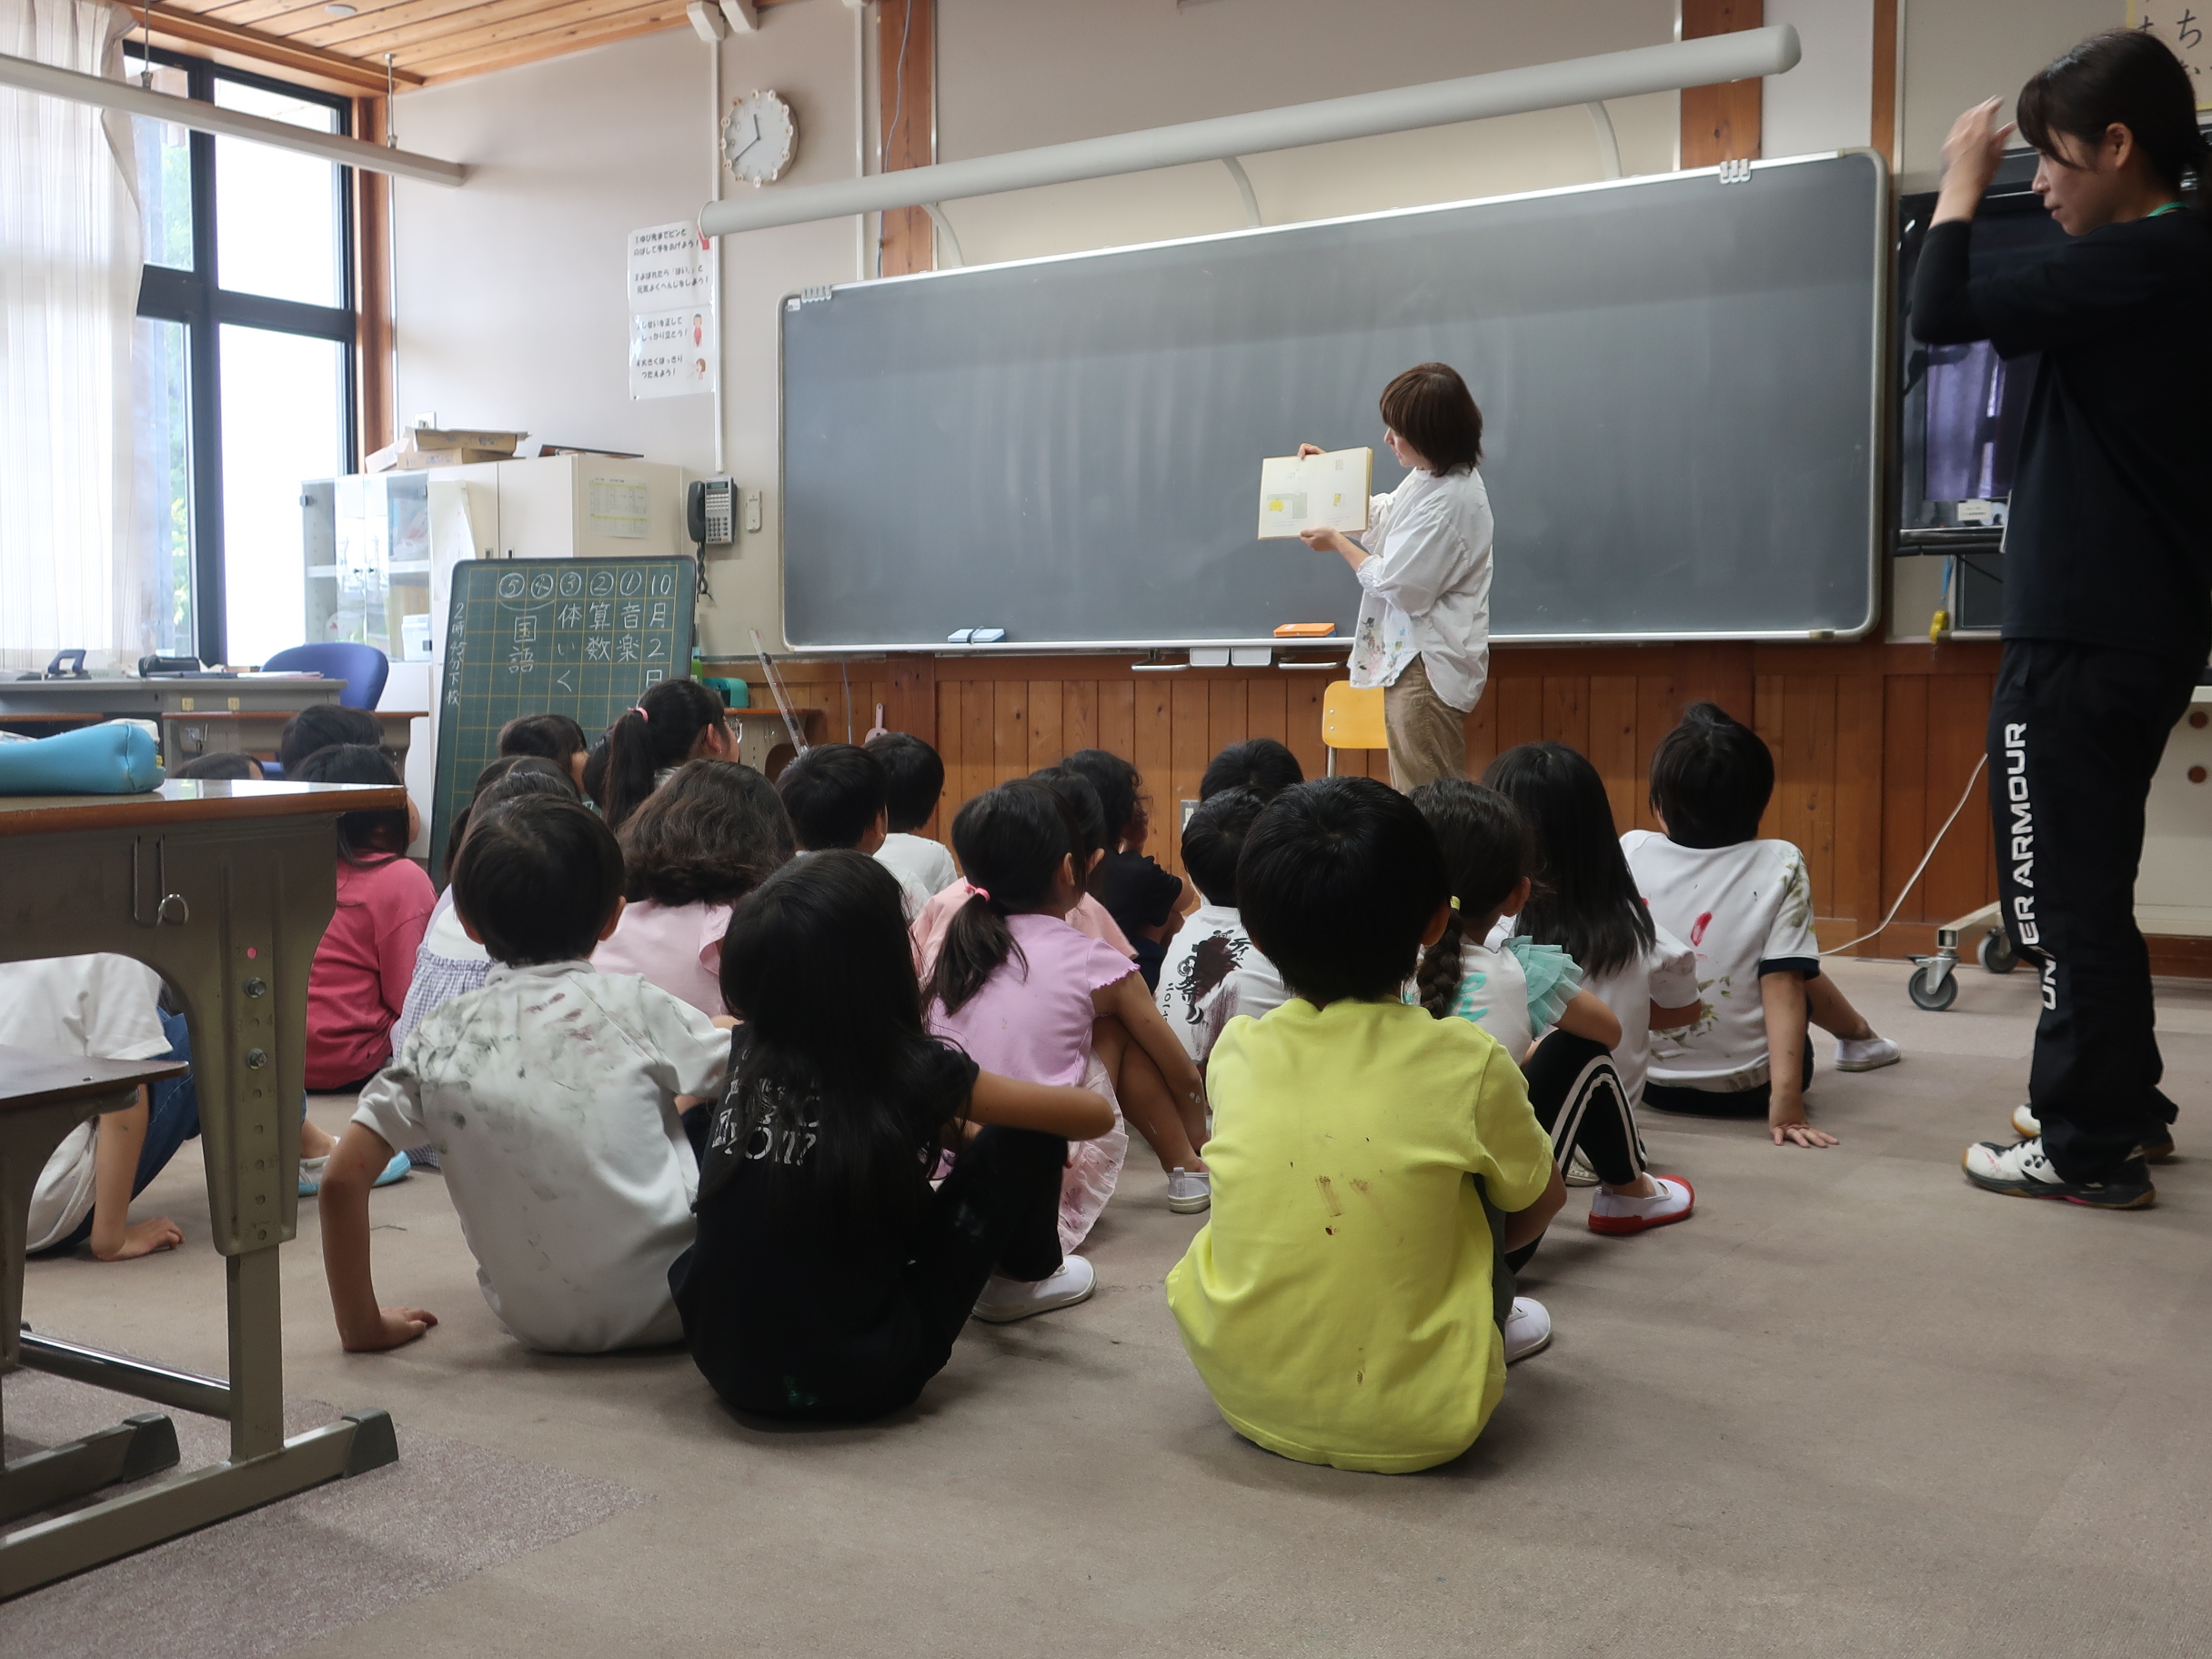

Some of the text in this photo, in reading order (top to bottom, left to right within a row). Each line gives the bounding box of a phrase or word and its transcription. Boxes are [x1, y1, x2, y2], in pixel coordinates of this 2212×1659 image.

[508, 615, 538, 674] 国語
[2004, 722, 2057, 1010] UNER ARMOUR
